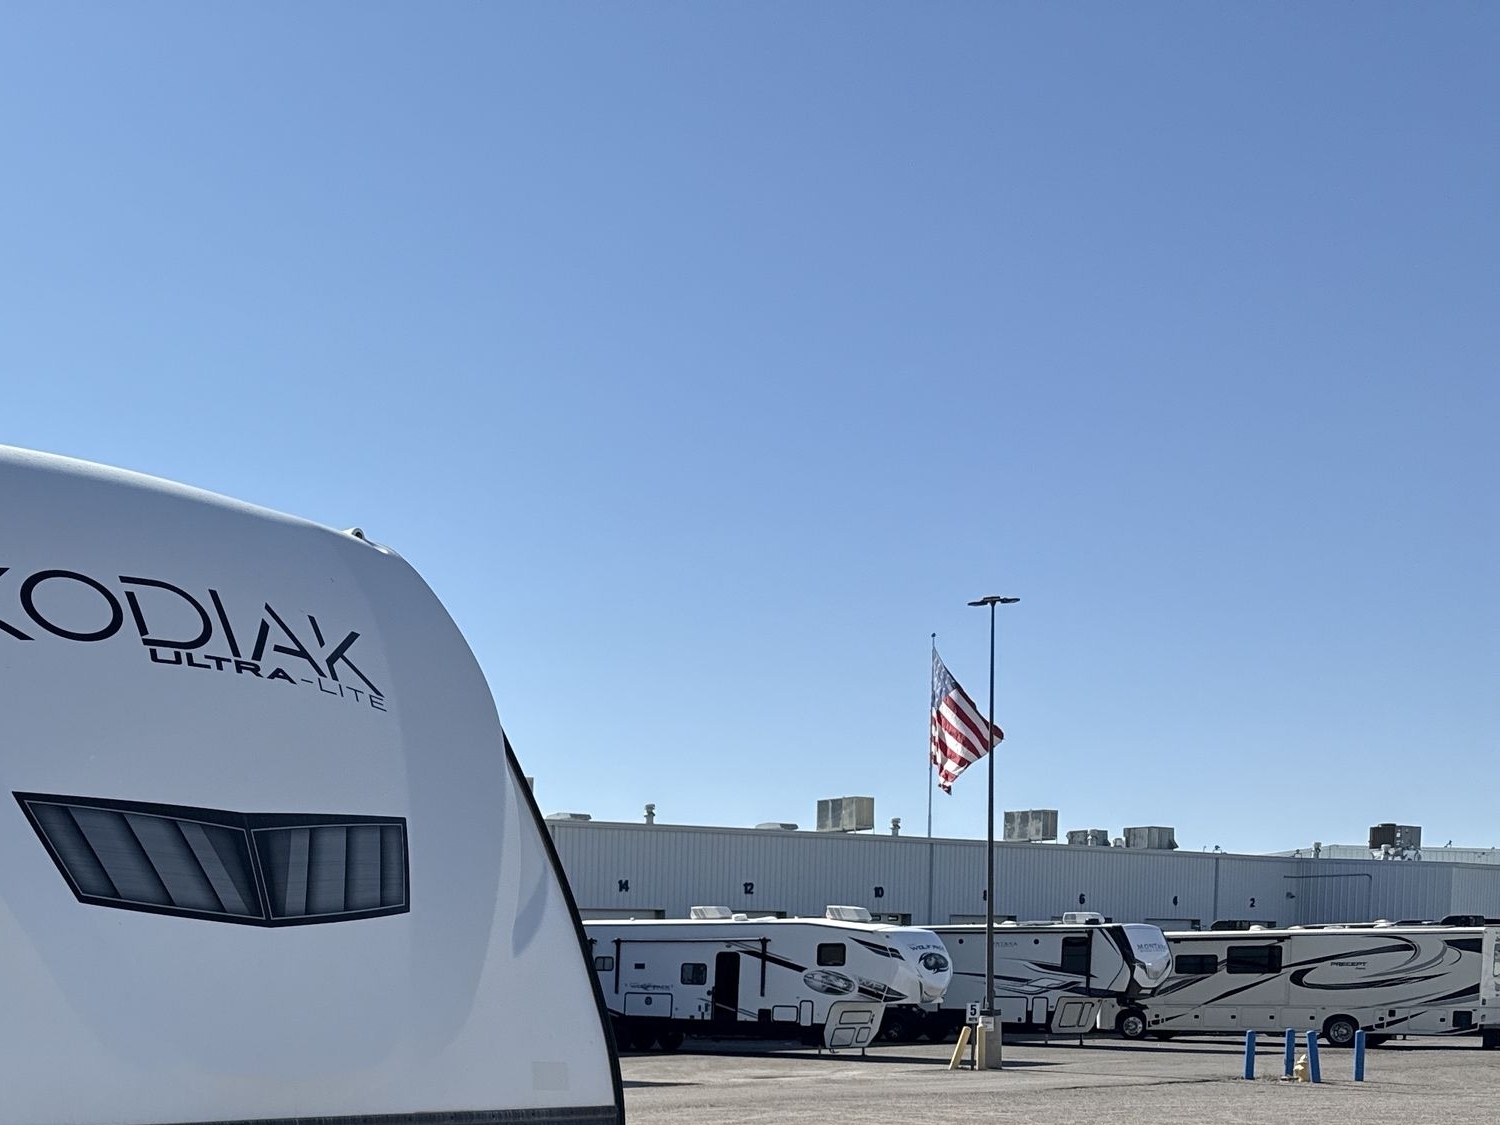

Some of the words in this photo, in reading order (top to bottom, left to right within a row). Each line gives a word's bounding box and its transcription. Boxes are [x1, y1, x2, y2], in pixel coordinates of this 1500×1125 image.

[148, 647, 388, 713] ULTRA-LITE
[618, 879, 630, 892] 14
[743, 882, 755, 895] 12
[873, 886, 885, 898] 10
[1079, 893, 1086, 905] 6
[1250, 897, 1256, 908] 2
[970, 1004, 977, 1016] 5
